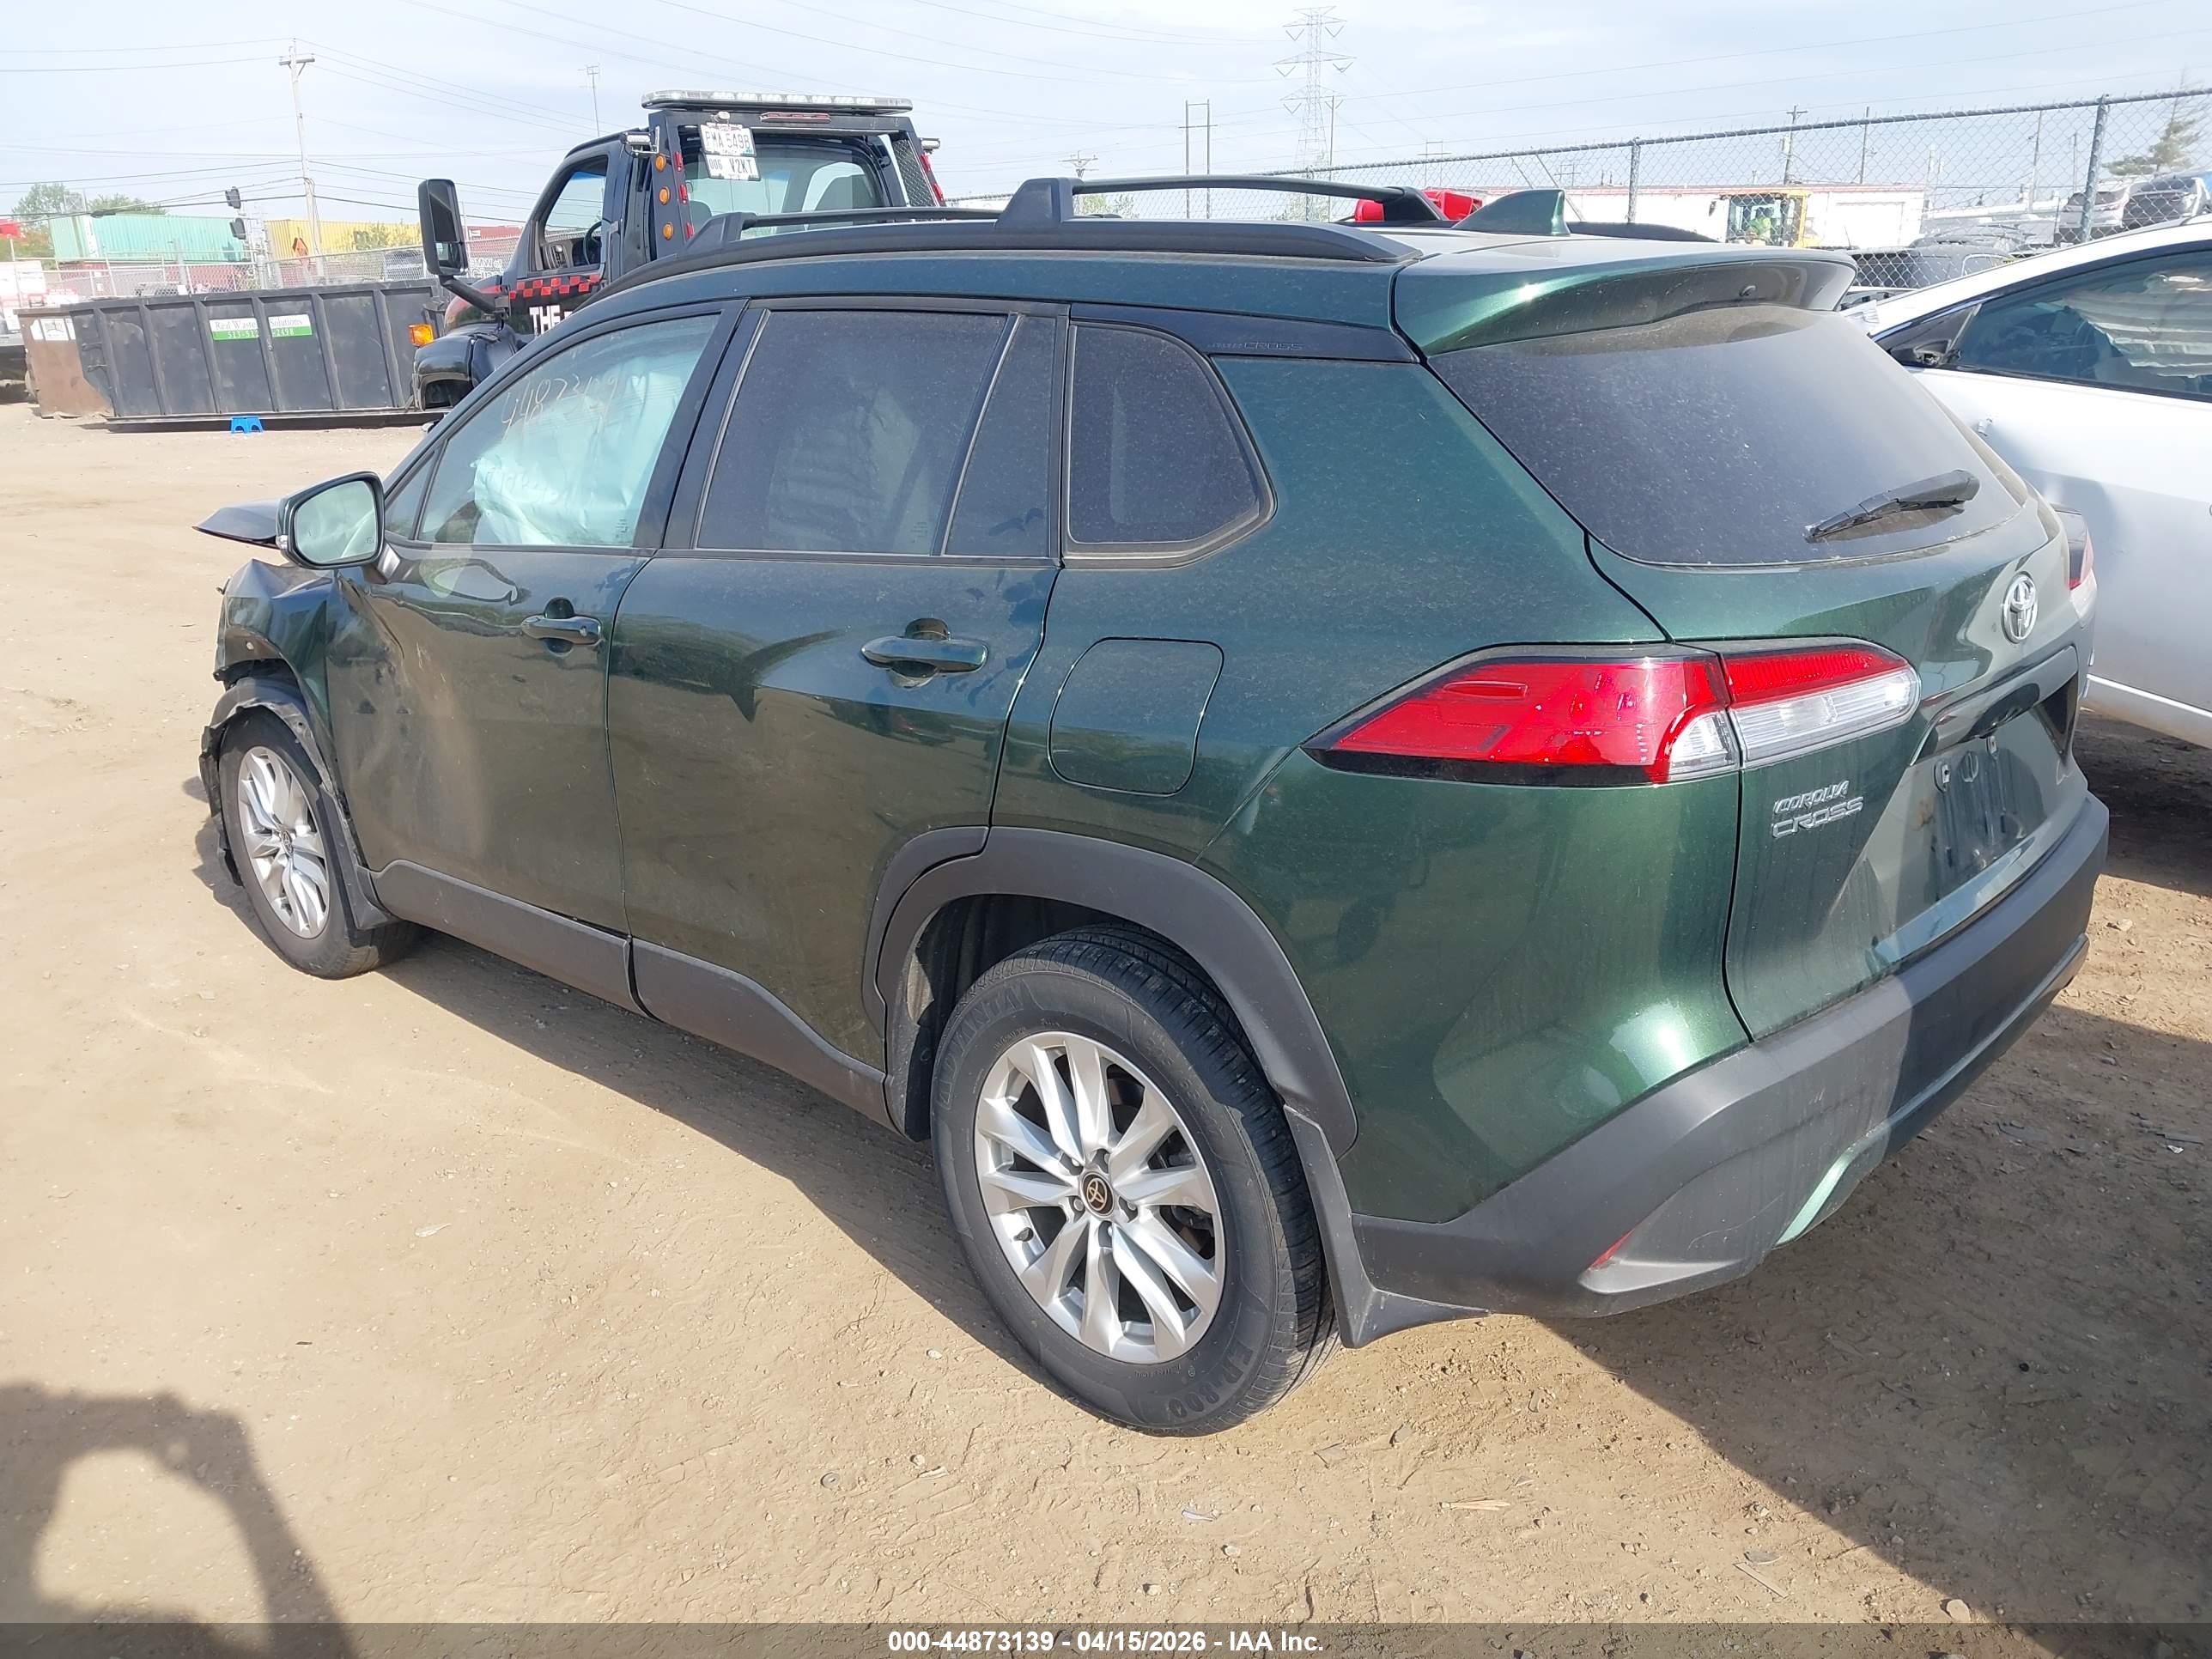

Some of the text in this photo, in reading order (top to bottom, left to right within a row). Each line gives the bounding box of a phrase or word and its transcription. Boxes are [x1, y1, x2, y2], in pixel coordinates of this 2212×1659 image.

[529, 305, 561, 337] THE
[1771, 780, 1864, 839] COROLLA CROSS
